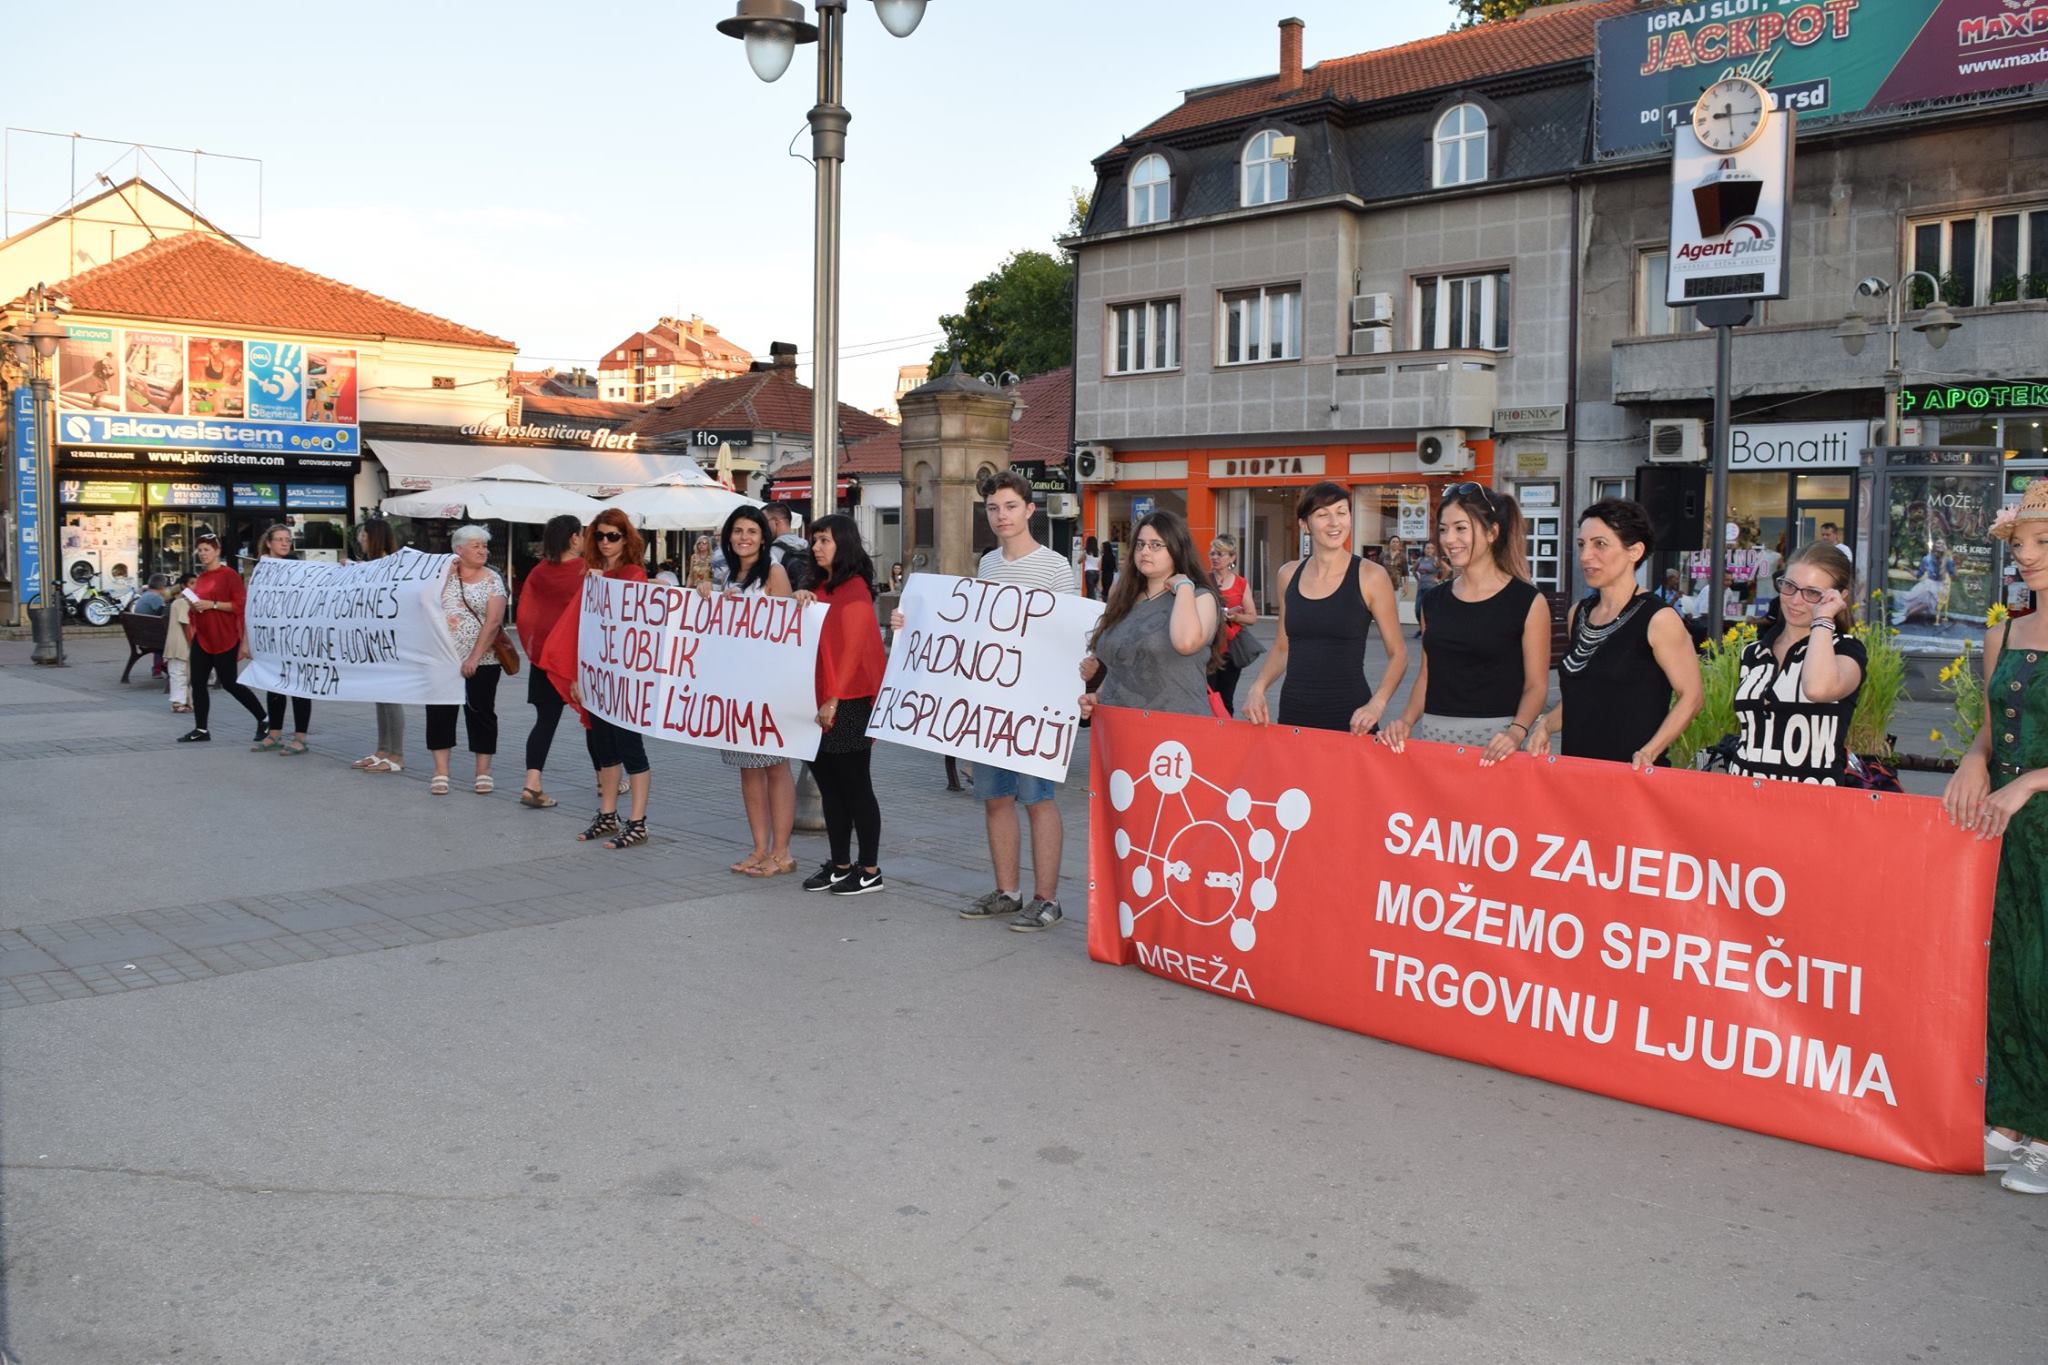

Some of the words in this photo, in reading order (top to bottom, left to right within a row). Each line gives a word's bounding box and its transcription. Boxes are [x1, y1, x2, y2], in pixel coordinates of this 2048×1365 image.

[1647, 7, 1706, 33] IGRAJ
[1640, 0, 1859, 76] JACKPOT
[1640, 108, 1660, 124] DO
[1785, 84, 1824, 109] rsd
[251, 403, 259, 417] 5
[1497, 409, 1548, 420] PHOENIX
[94, 417, 283, 443] Jakovsistem
[497, 423, 591, 440] poslastičara
[590, 427, 638, 450] flert
[697, 431, 718, 446] flo
[1732, 430, 1847, 463] Bonatti
[148, 450, 285, 466] www.jakovsistem.com
[1226, 458, 1302, 476] DIOPTA
[260, 488, 272, 496] 72
[326, 583, 398, 620] POSTANEŠ
[621, 582, 802, 647] EKSPLOATACIJA
[937, 577, 1056, 637] STOP
[599, 619, 619, 664] JE
[622, 627, 700, 679] OBLIK
[296, 662, 339, 695] MREŽA
[580, 661, 655, 727] TRGOVINE
[662, 683, 784, 748] LJUDIMA
[1154, 751, 1184, 779] at
[1383, 811, 1519, 872] SAMO
[1529, 832, 1786, 917] ZAJEDNO
[1375, 880, 1585, 960] MOŽEMO
[1600, 922, 1863, 1016] SPREČITI
[1135, 940, 1256, 1000] MREŽA
[1369, 948, 1619, 1046] TRGOVINU
[1634, 1006, 1898, 1107] LJUDIMA
